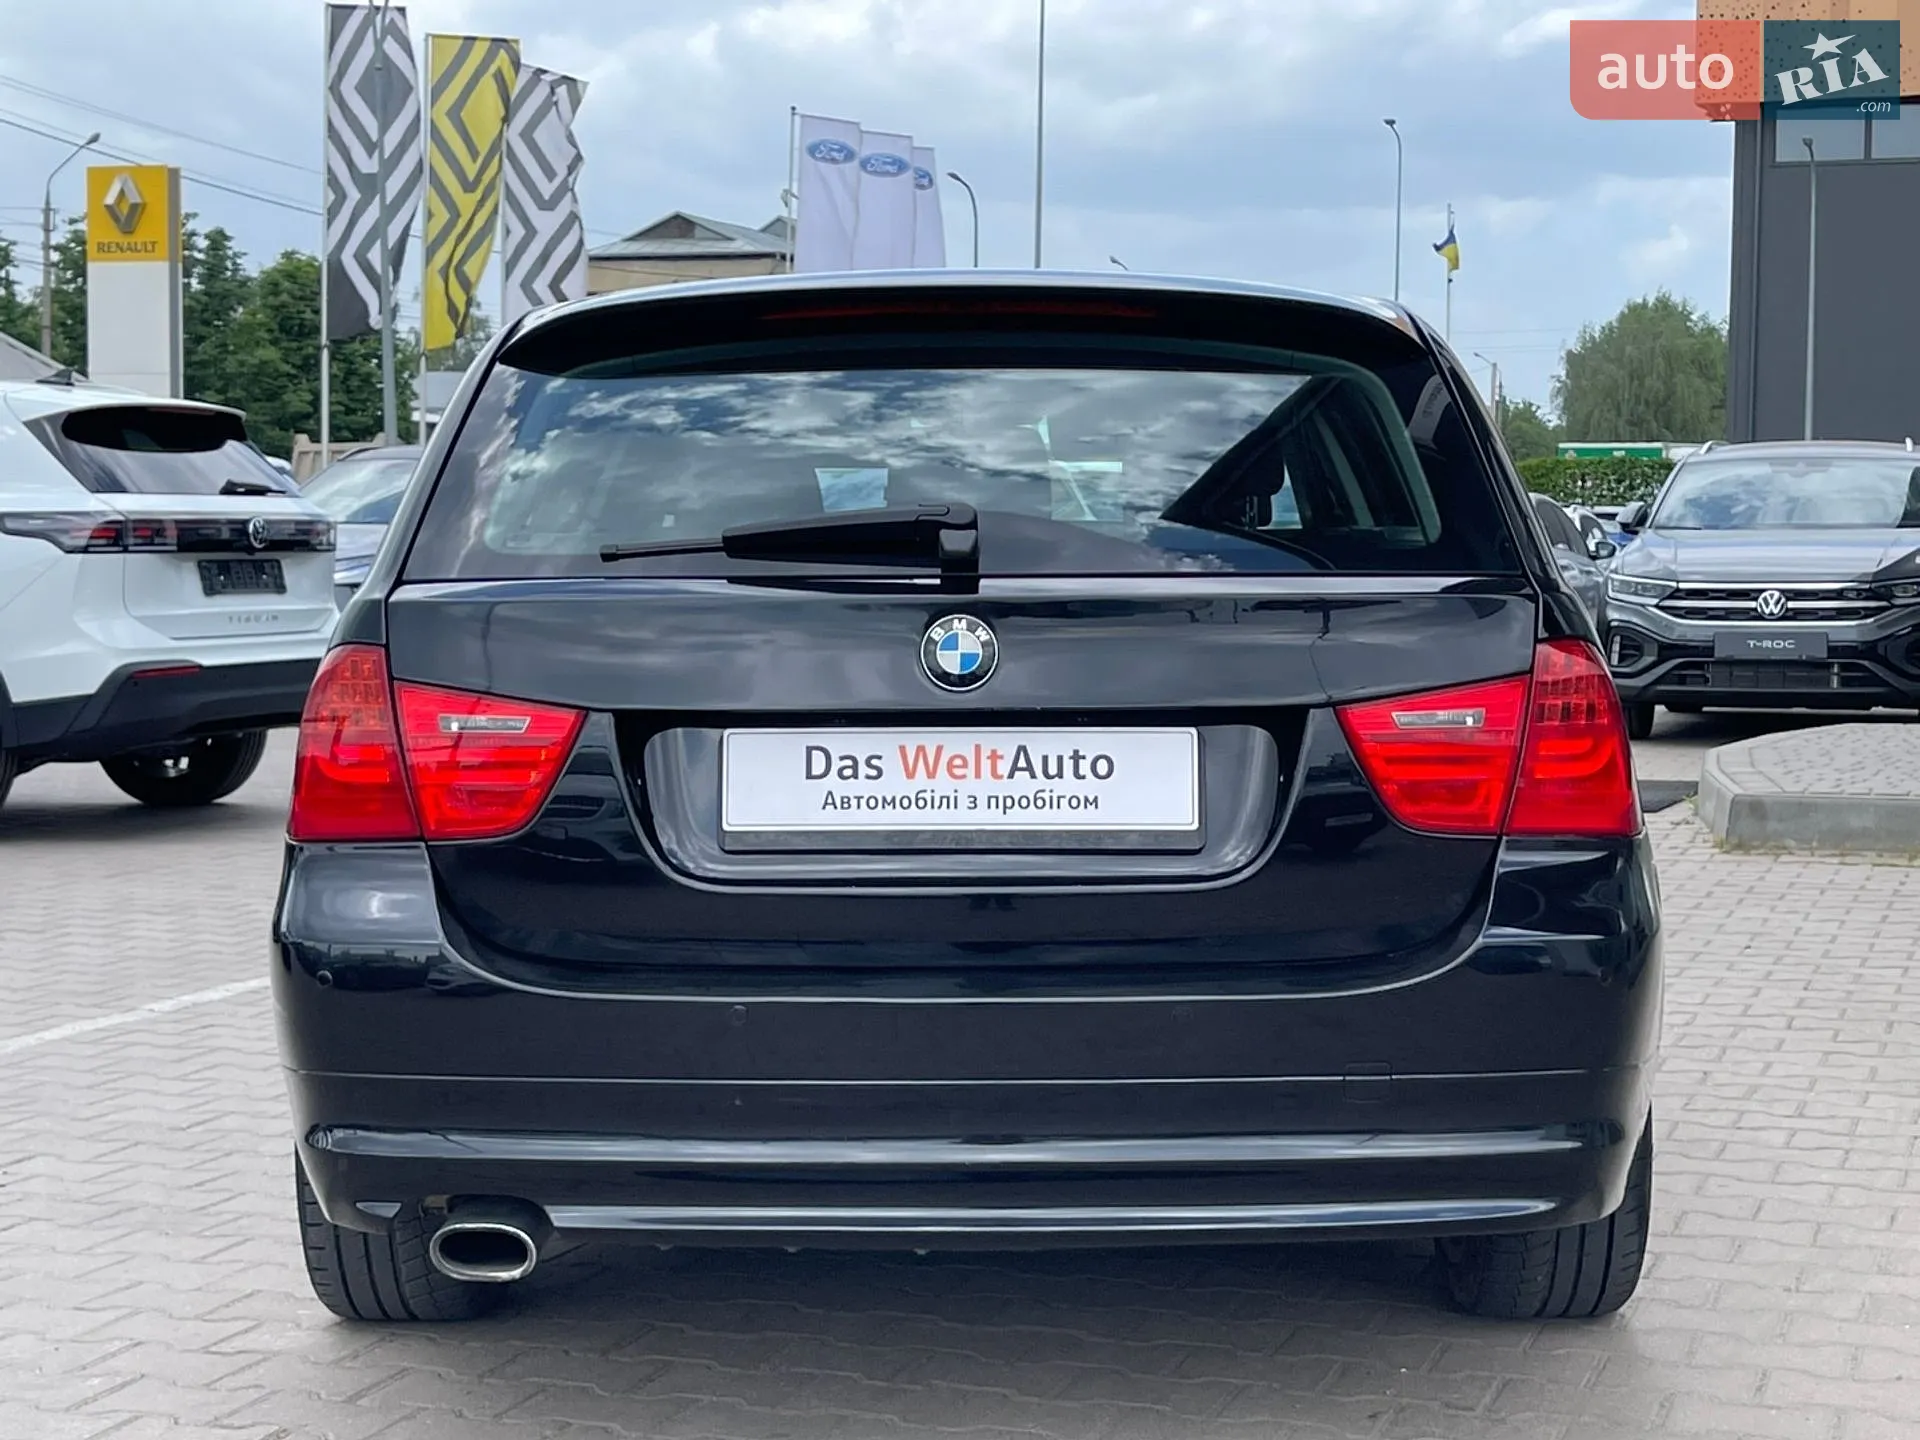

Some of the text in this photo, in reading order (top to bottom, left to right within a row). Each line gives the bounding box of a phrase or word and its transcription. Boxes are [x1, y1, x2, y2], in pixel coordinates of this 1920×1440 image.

[97, 241, 158, 254] RENAULT
[930, 618, 990, 642] BMW
[1747, 639, 1796, 648] T-ROC
[805, 743, 1115, 780] Das WeltAuto
[821, 789, 1099, 815] Автомобілі з пробігом
